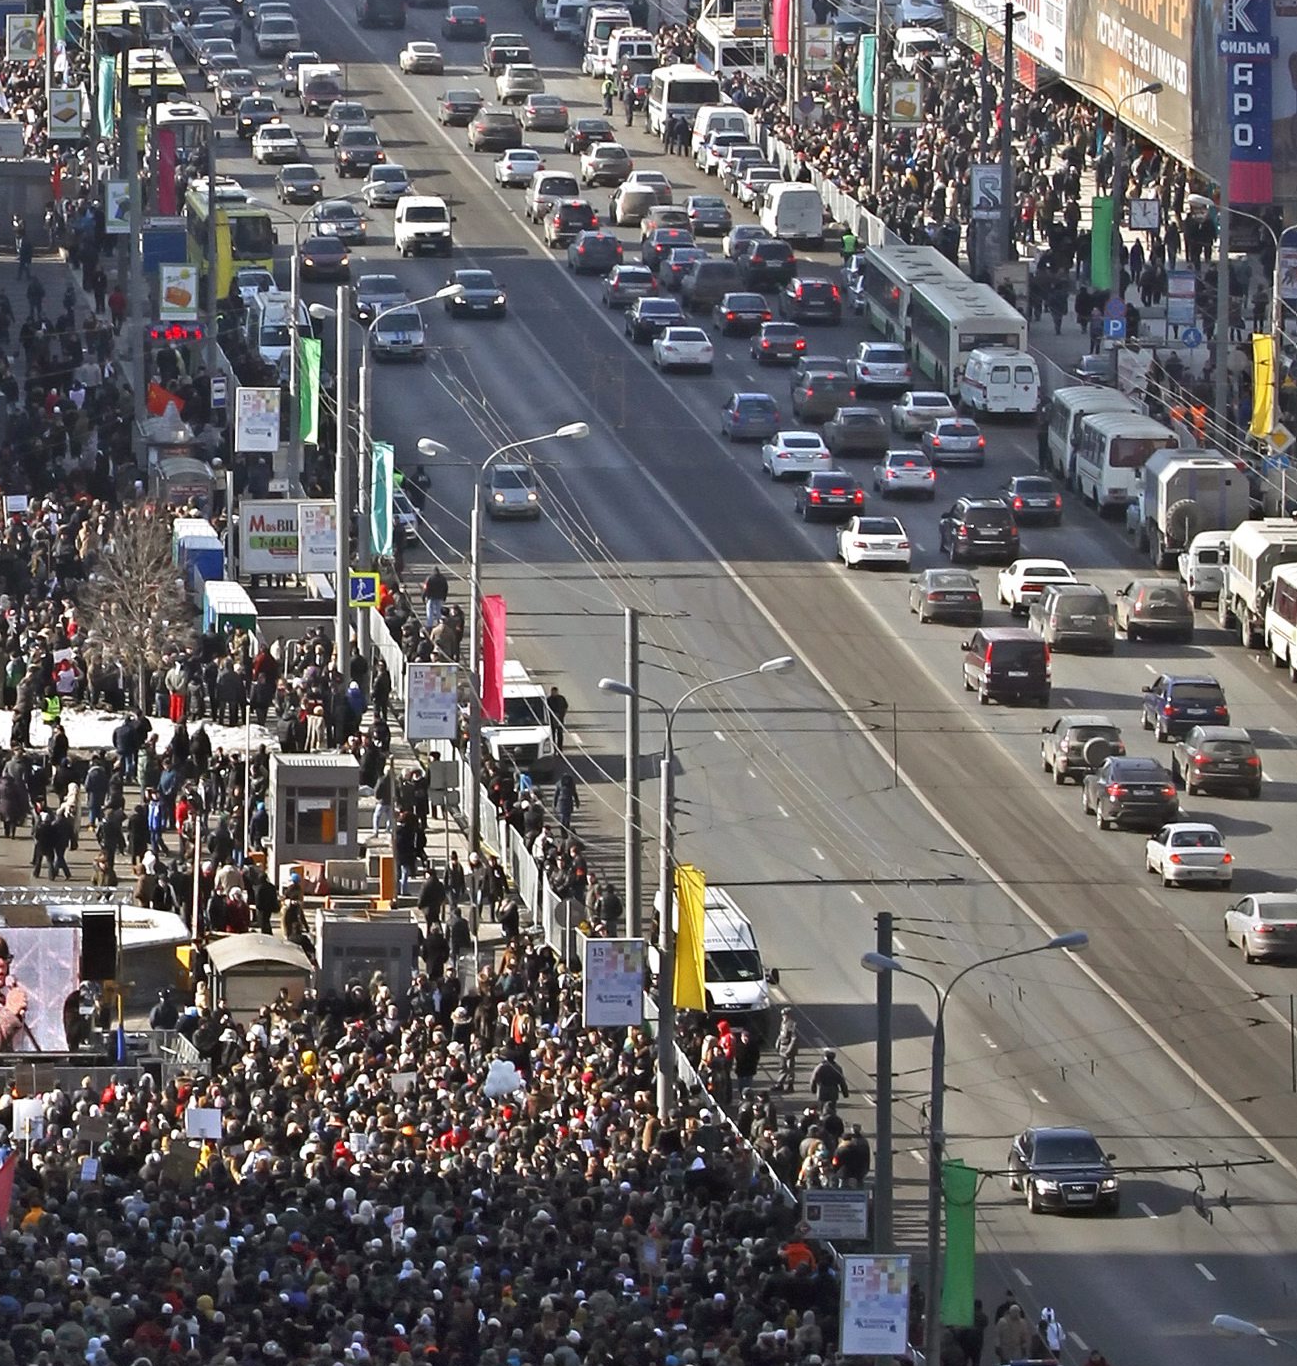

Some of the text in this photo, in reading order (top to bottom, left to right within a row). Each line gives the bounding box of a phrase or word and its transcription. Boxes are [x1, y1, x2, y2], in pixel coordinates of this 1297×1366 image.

[1220, 39, 1271, 55] ФИЛЬМ
[592, 947, 604, 957] 15
[851, 1265, 865, 1276] 15
